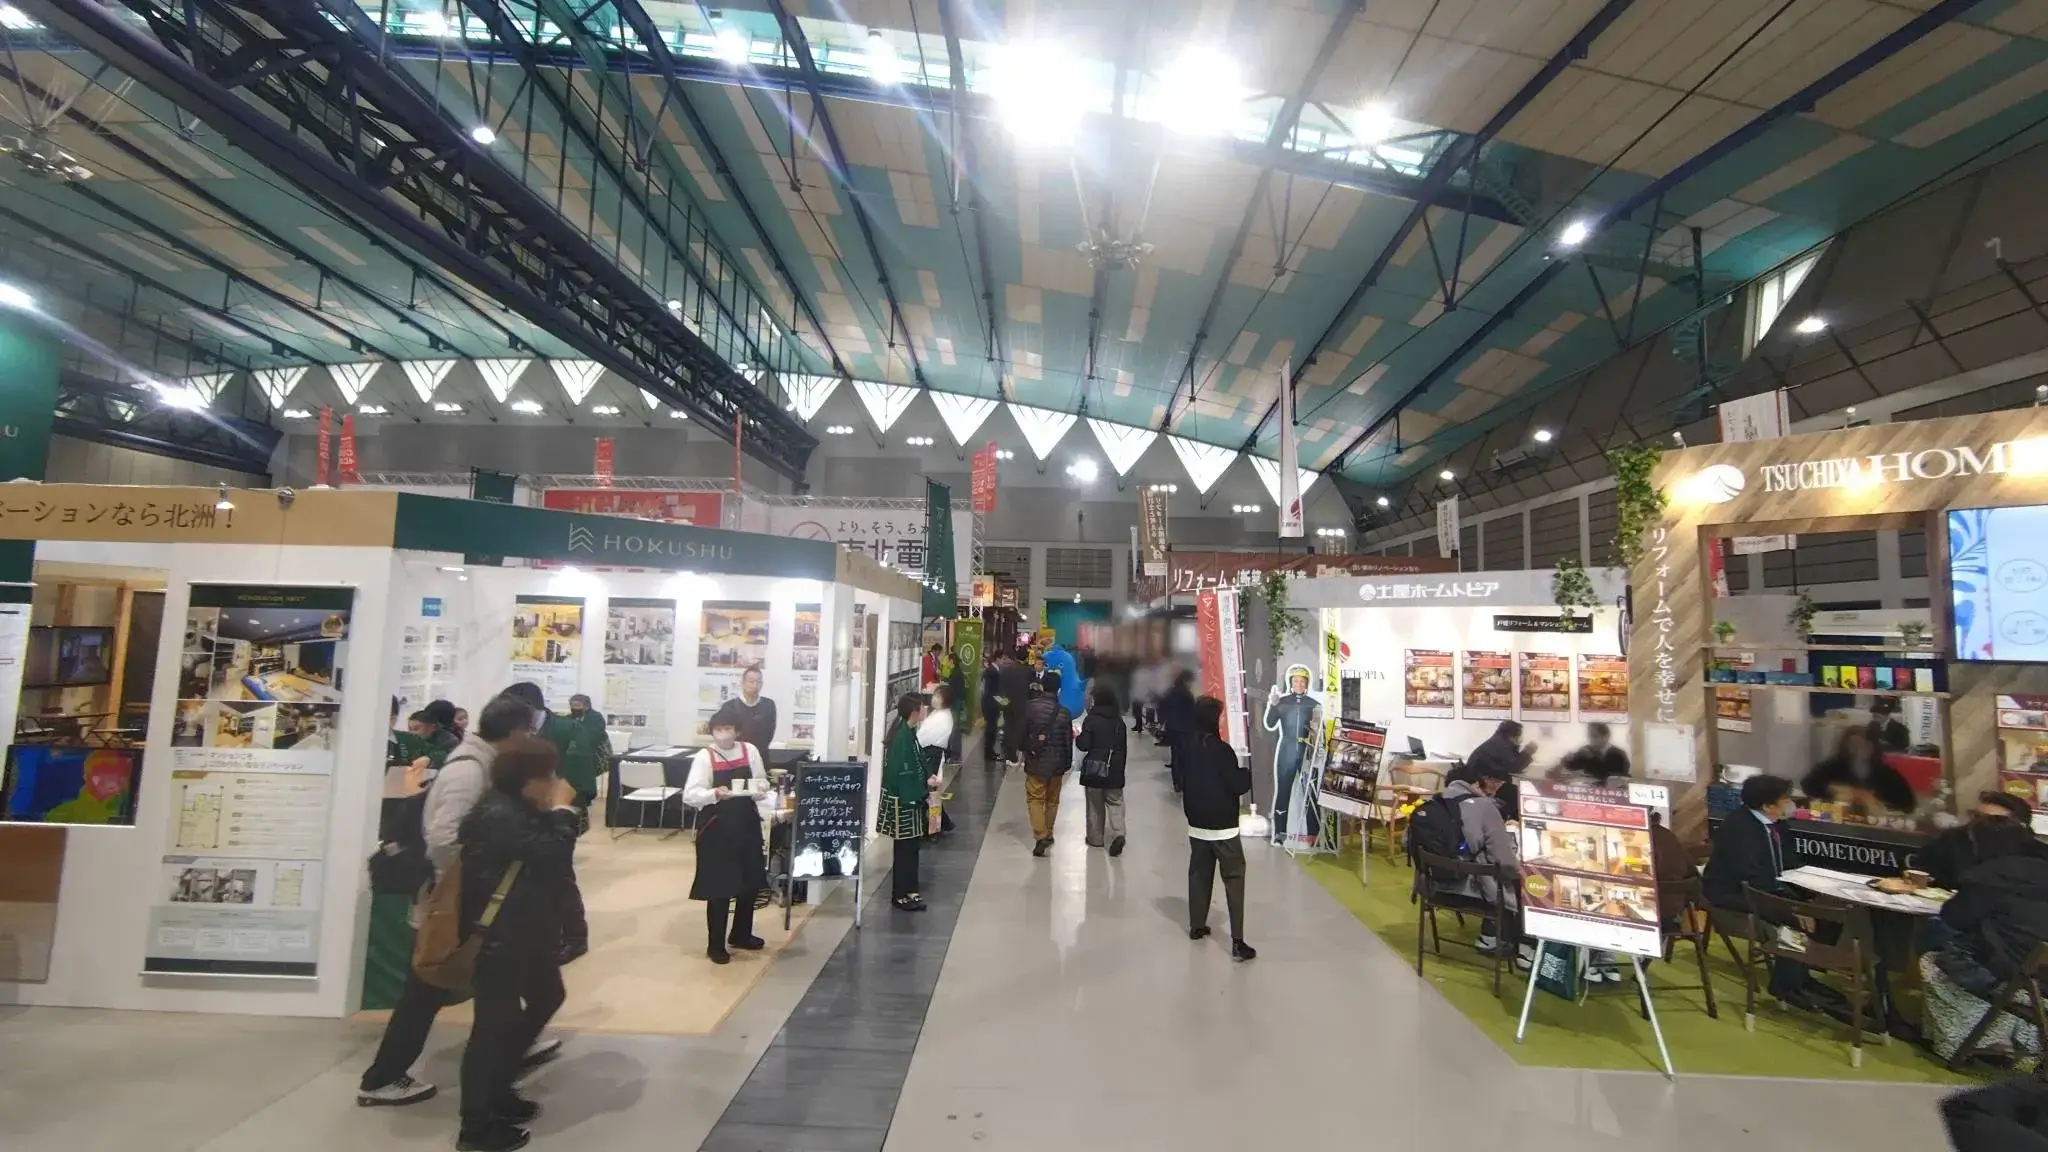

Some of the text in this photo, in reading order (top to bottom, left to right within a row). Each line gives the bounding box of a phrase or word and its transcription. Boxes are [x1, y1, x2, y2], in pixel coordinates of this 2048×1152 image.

[1761, 437, 2040, 492] TSUCHIYA HOM
[0, 502, 234, 528] ーションなら北洲！
[603, 534, 733, 560] HOKUSHU
[1375, 581, 1499, 599] 土屋ホームトピア
[1652, 527, 1676, 723] リフォームで人を幸せに
[800, 797, 821, 805] CAFE
[1794, 837, 1899, 868] HOMETOPIA
